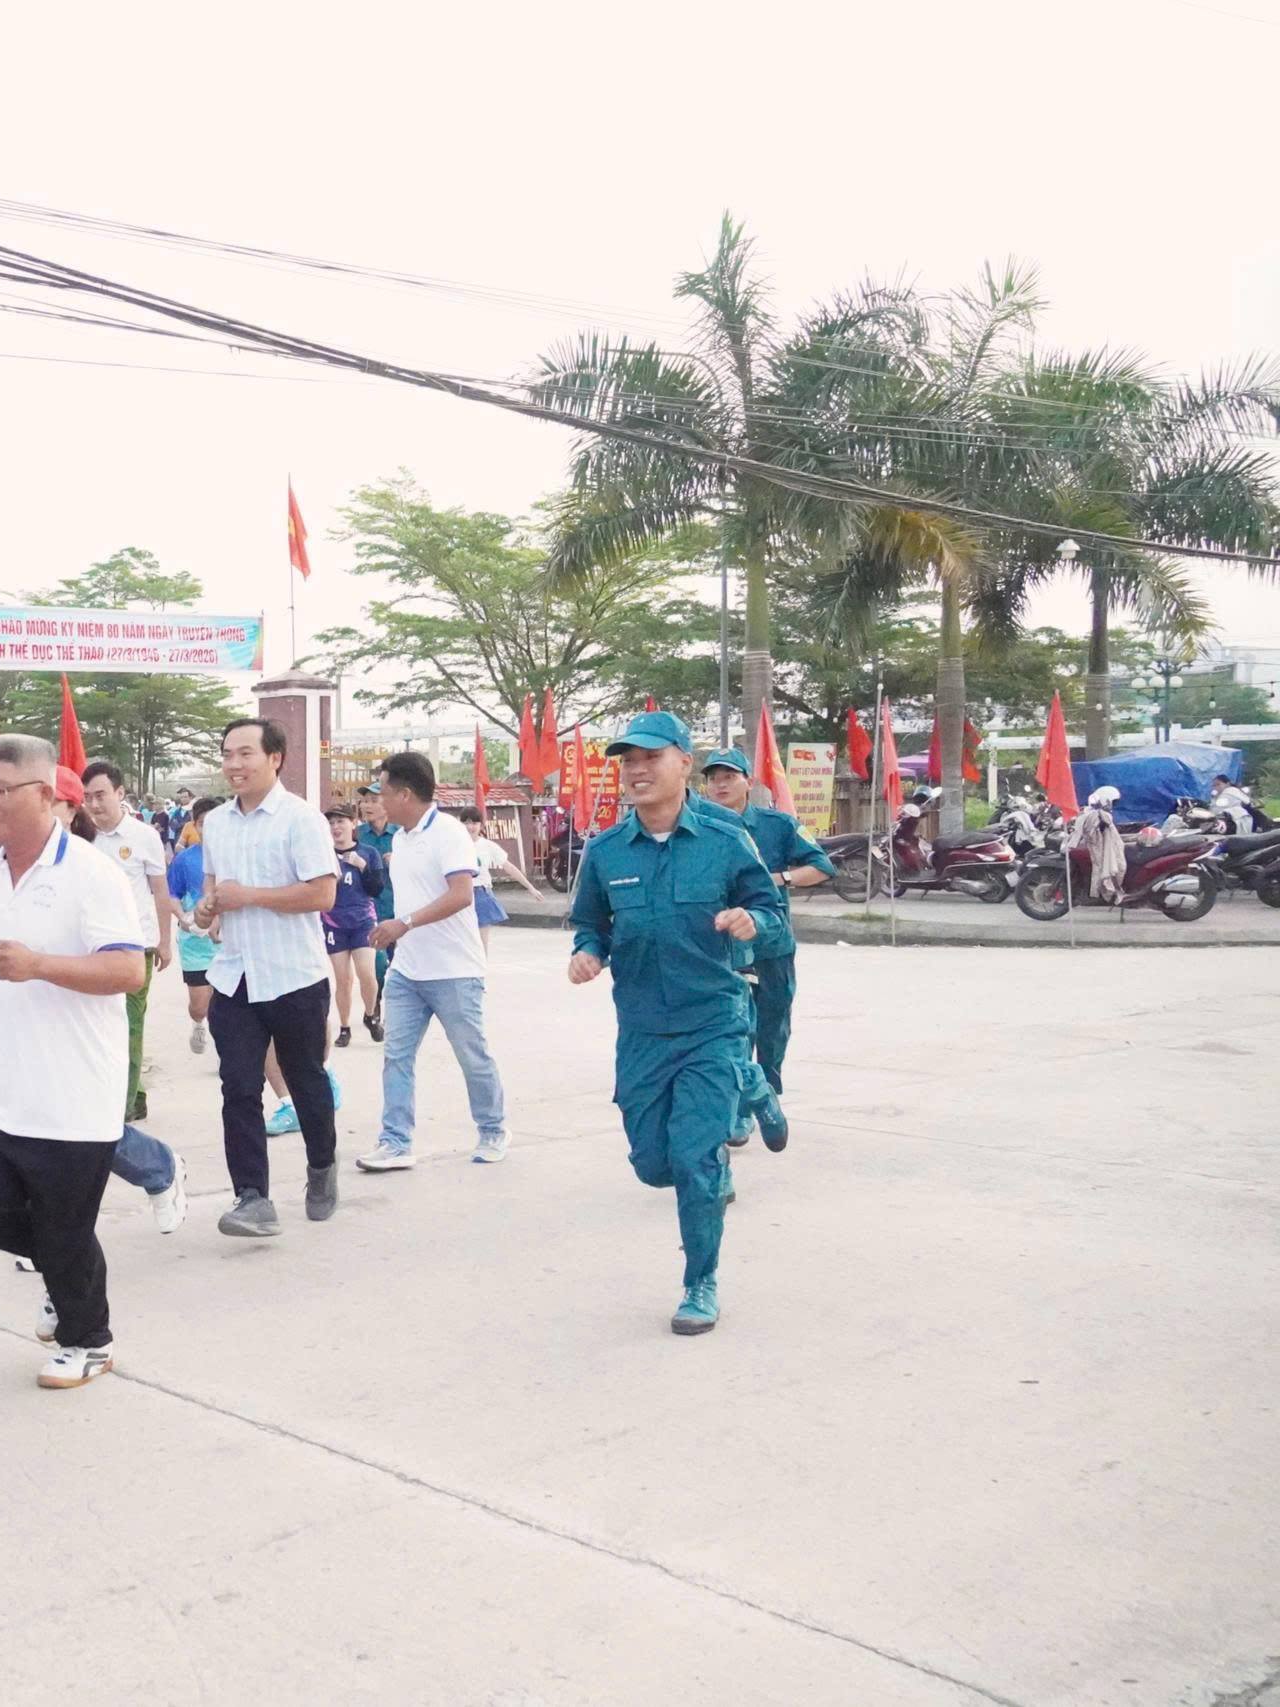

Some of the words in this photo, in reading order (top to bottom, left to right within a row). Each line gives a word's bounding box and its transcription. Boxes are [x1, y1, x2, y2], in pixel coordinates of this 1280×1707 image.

[26, 616, 57, 636] MỪNG
[77, 620, 104, 641] NIỆM
[107, 624, 119, 639] 80
[122, 621, 145, 639] NĂM
[33, 644, 53, 663] DỤC
[78, 646, 103, 661] THAO
[343, 871, 353, 886] 4
[327, 931, 336, 946] 4
